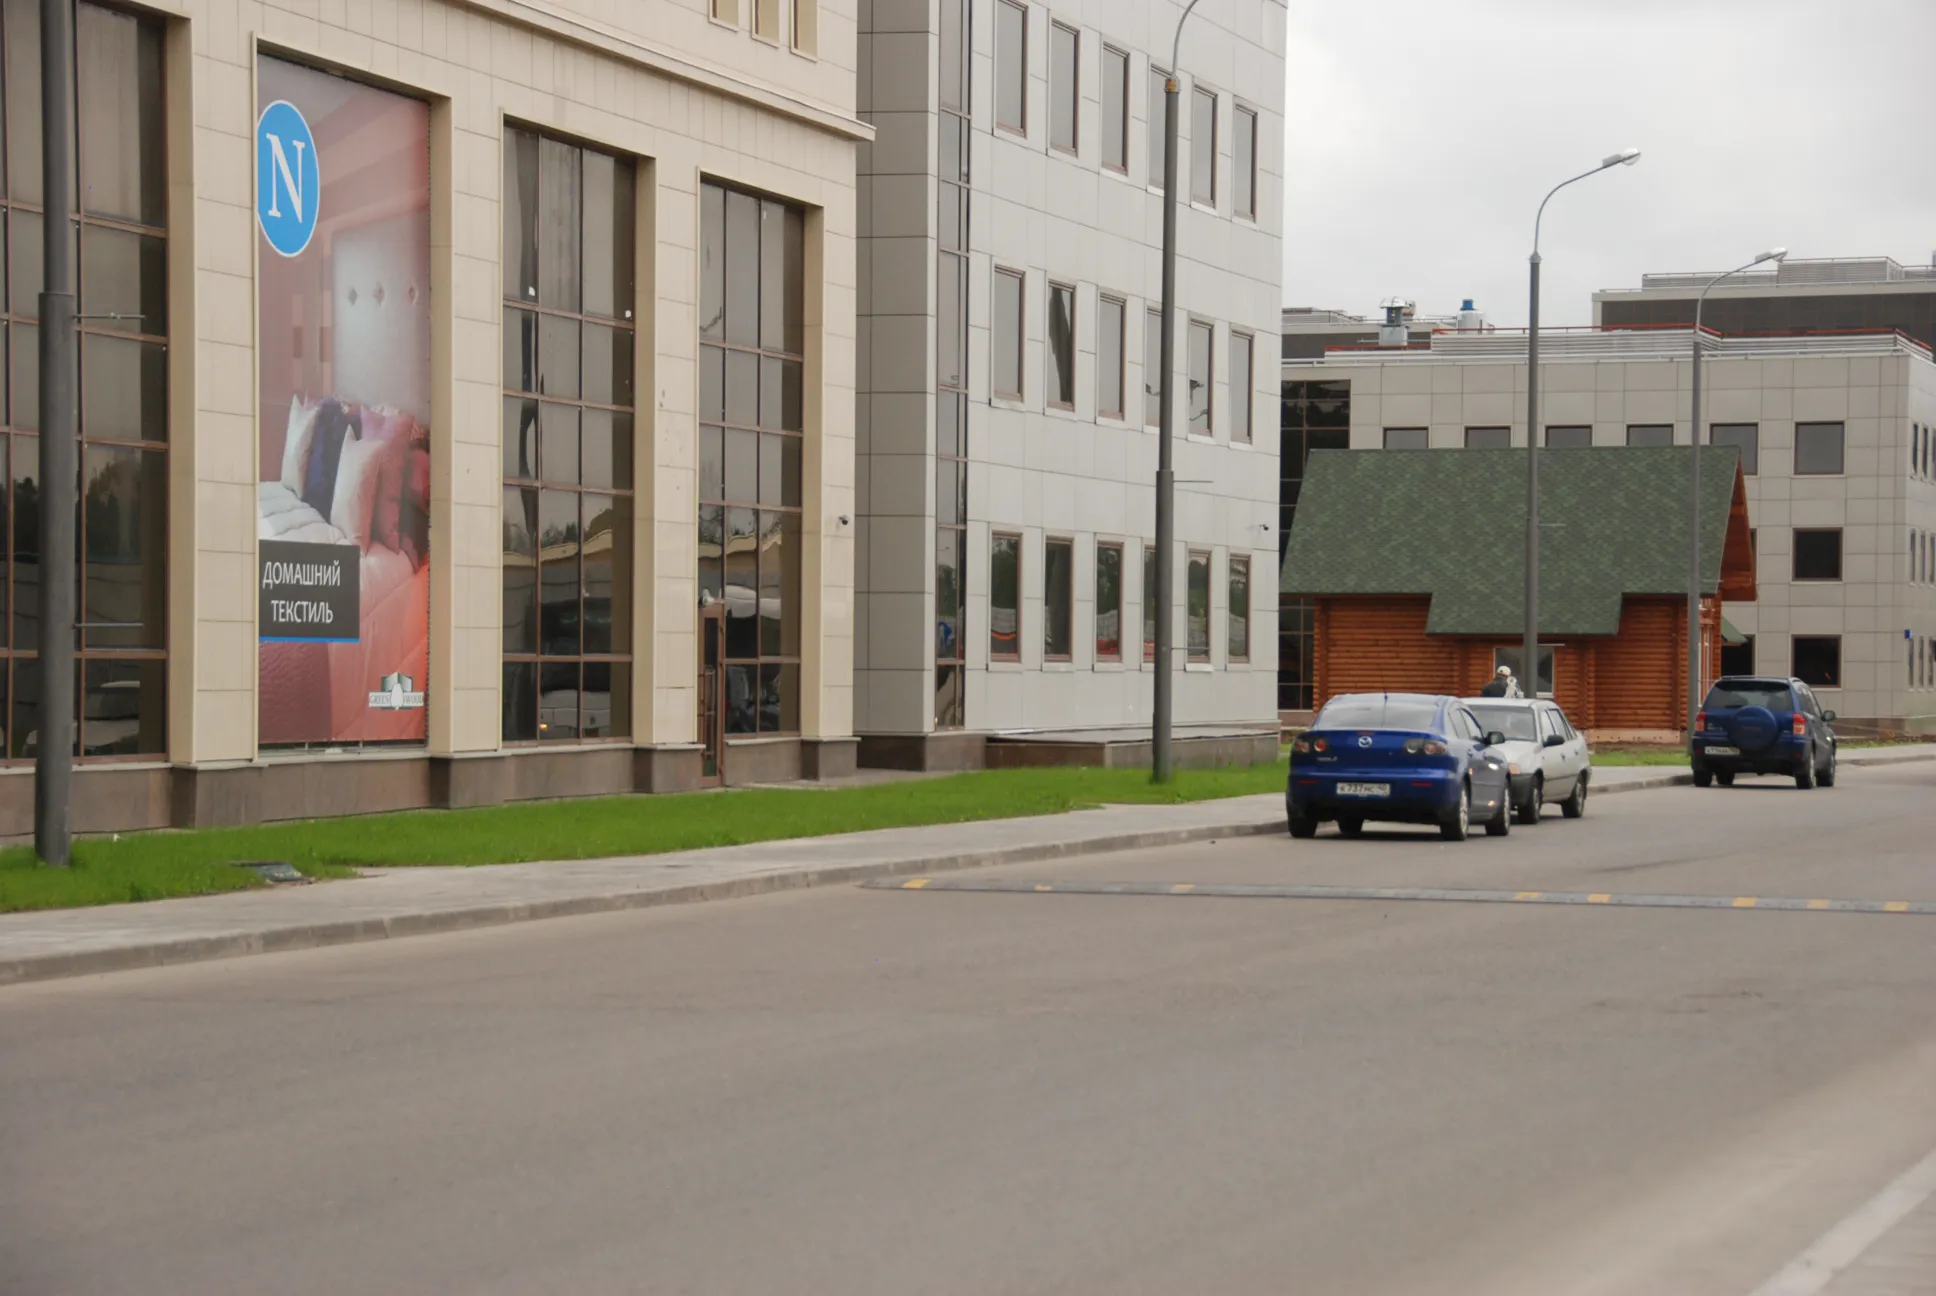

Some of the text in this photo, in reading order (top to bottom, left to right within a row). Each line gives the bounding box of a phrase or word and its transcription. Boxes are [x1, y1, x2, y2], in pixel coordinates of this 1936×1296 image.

[265, 132, 306, 223] N
[262, 559, 341, 589] ДОМАШНИЙ
[270, 600, 334, 624] ТЕКСТИЛЬ
